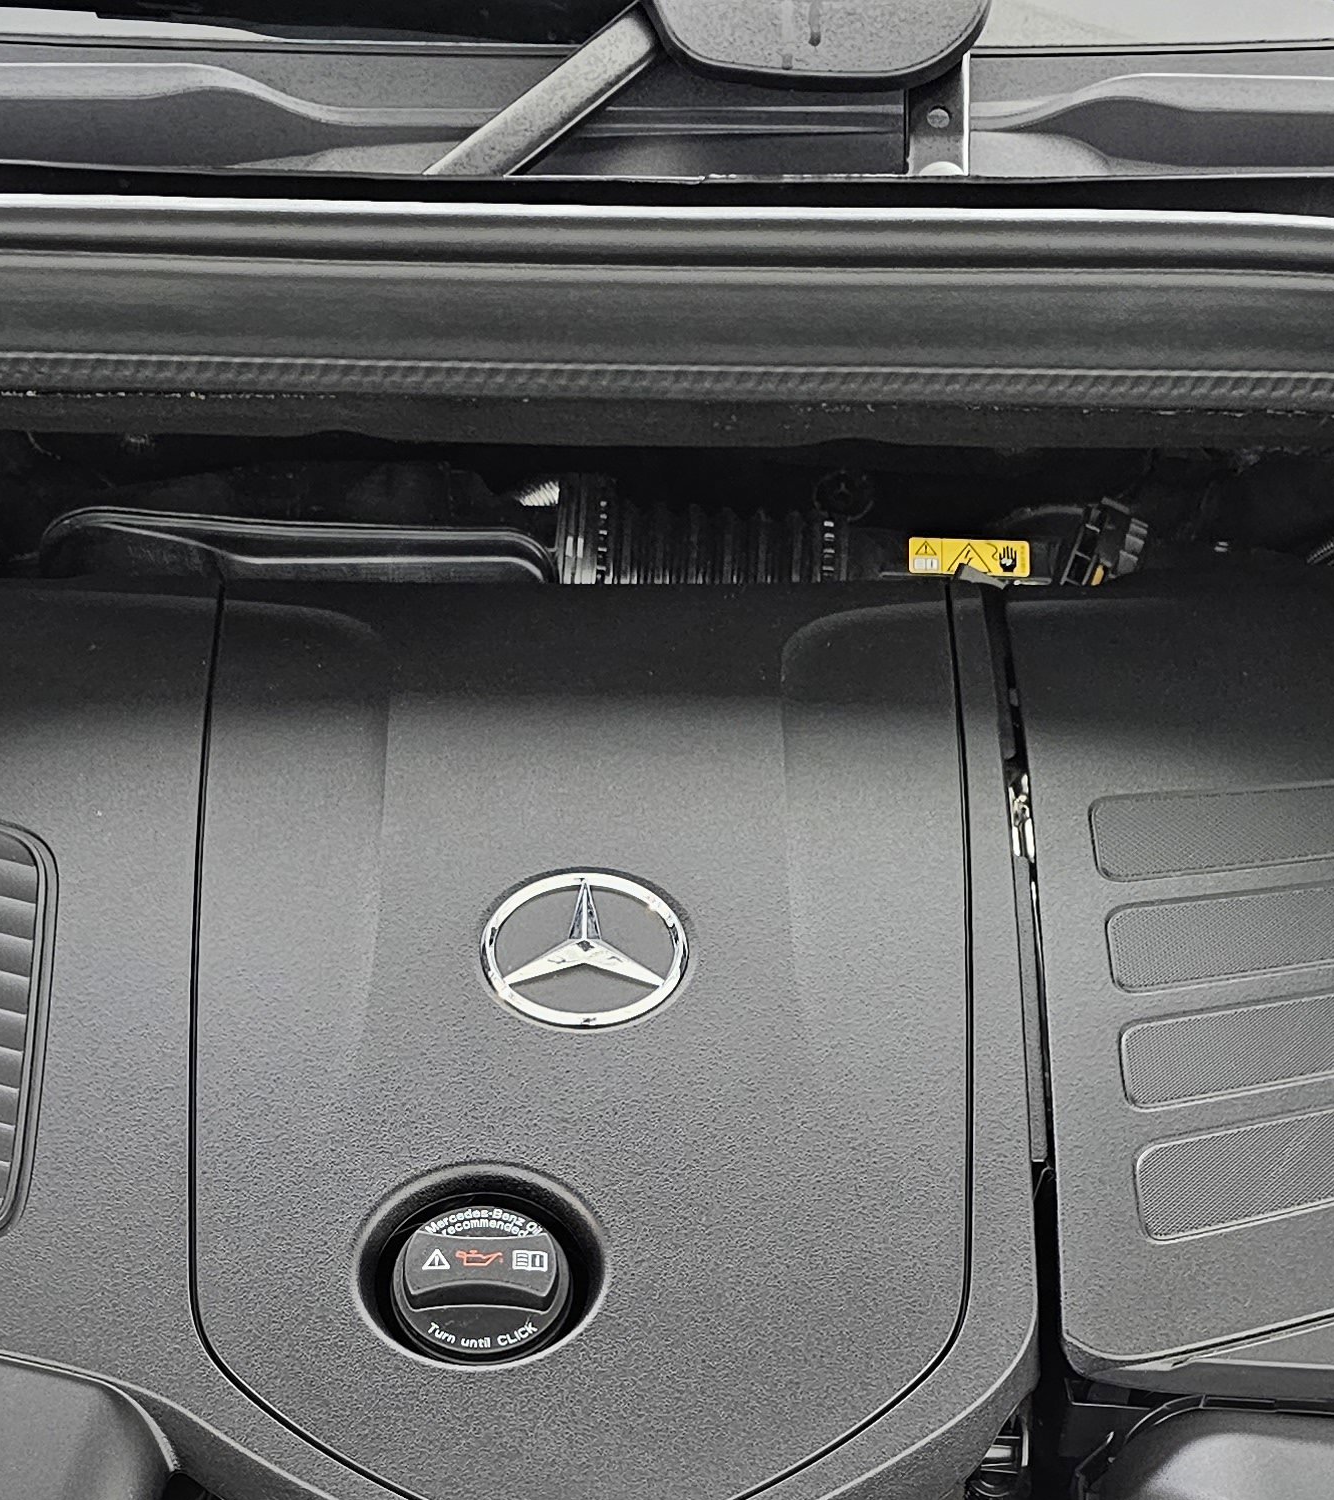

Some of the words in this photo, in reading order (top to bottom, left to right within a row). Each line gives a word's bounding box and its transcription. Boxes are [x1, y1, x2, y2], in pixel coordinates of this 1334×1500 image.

[425, 1208, 526, 1235] Mercedes-Benz
[526, 1221, 544, 1235] Oil
[441, 1218, 529, 1237] recommended
[427, 1322, 456, 1345] Turn
[461, 1336, 491, 1348] until
[496, 1321, 538, 1347] CLICK
